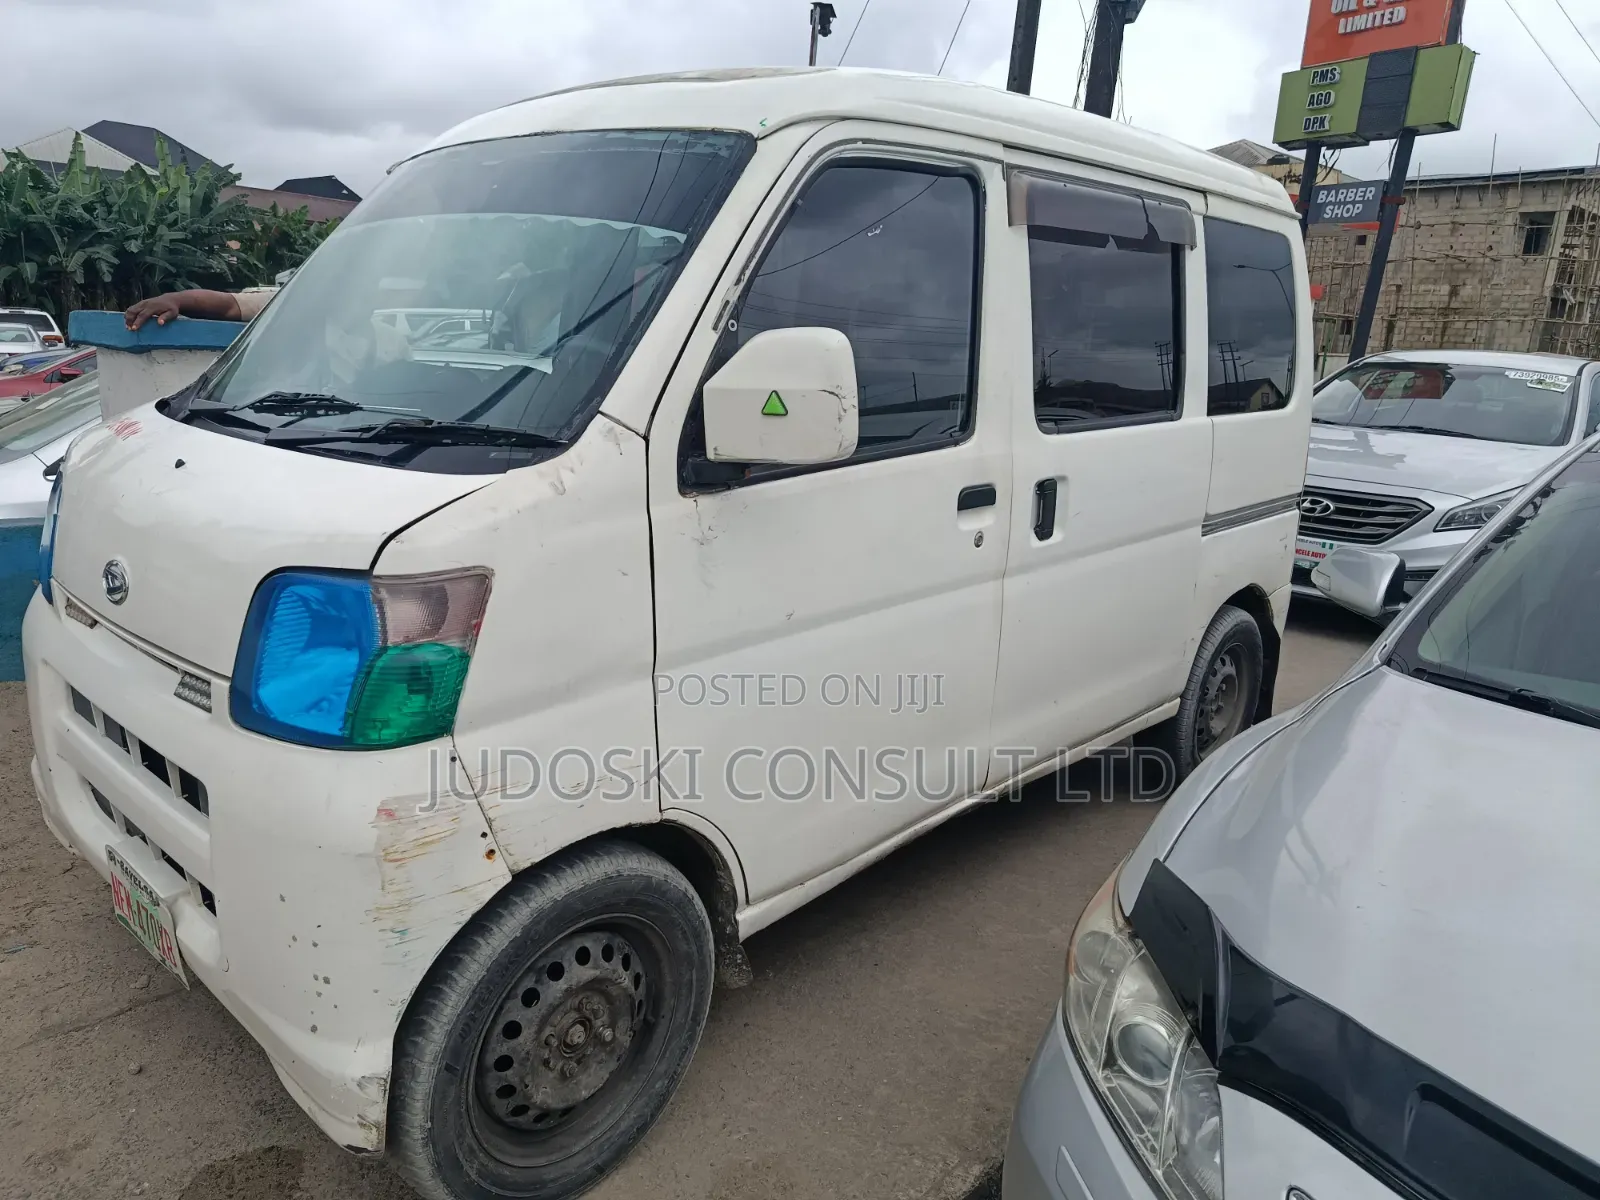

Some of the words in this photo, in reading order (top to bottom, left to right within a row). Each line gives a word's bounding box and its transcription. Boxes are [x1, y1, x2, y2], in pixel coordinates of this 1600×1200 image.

[1338, 6, 1406, 34] LIMITED
[1310, 66, 1340, 85] PMS
[1306, 90, 1335, 108] AGO
[1302, 114, 1331, 132] DPK
[1317, 187, 1376, 203] BARBER
[1323, 203, 1363, 218] SHOP
